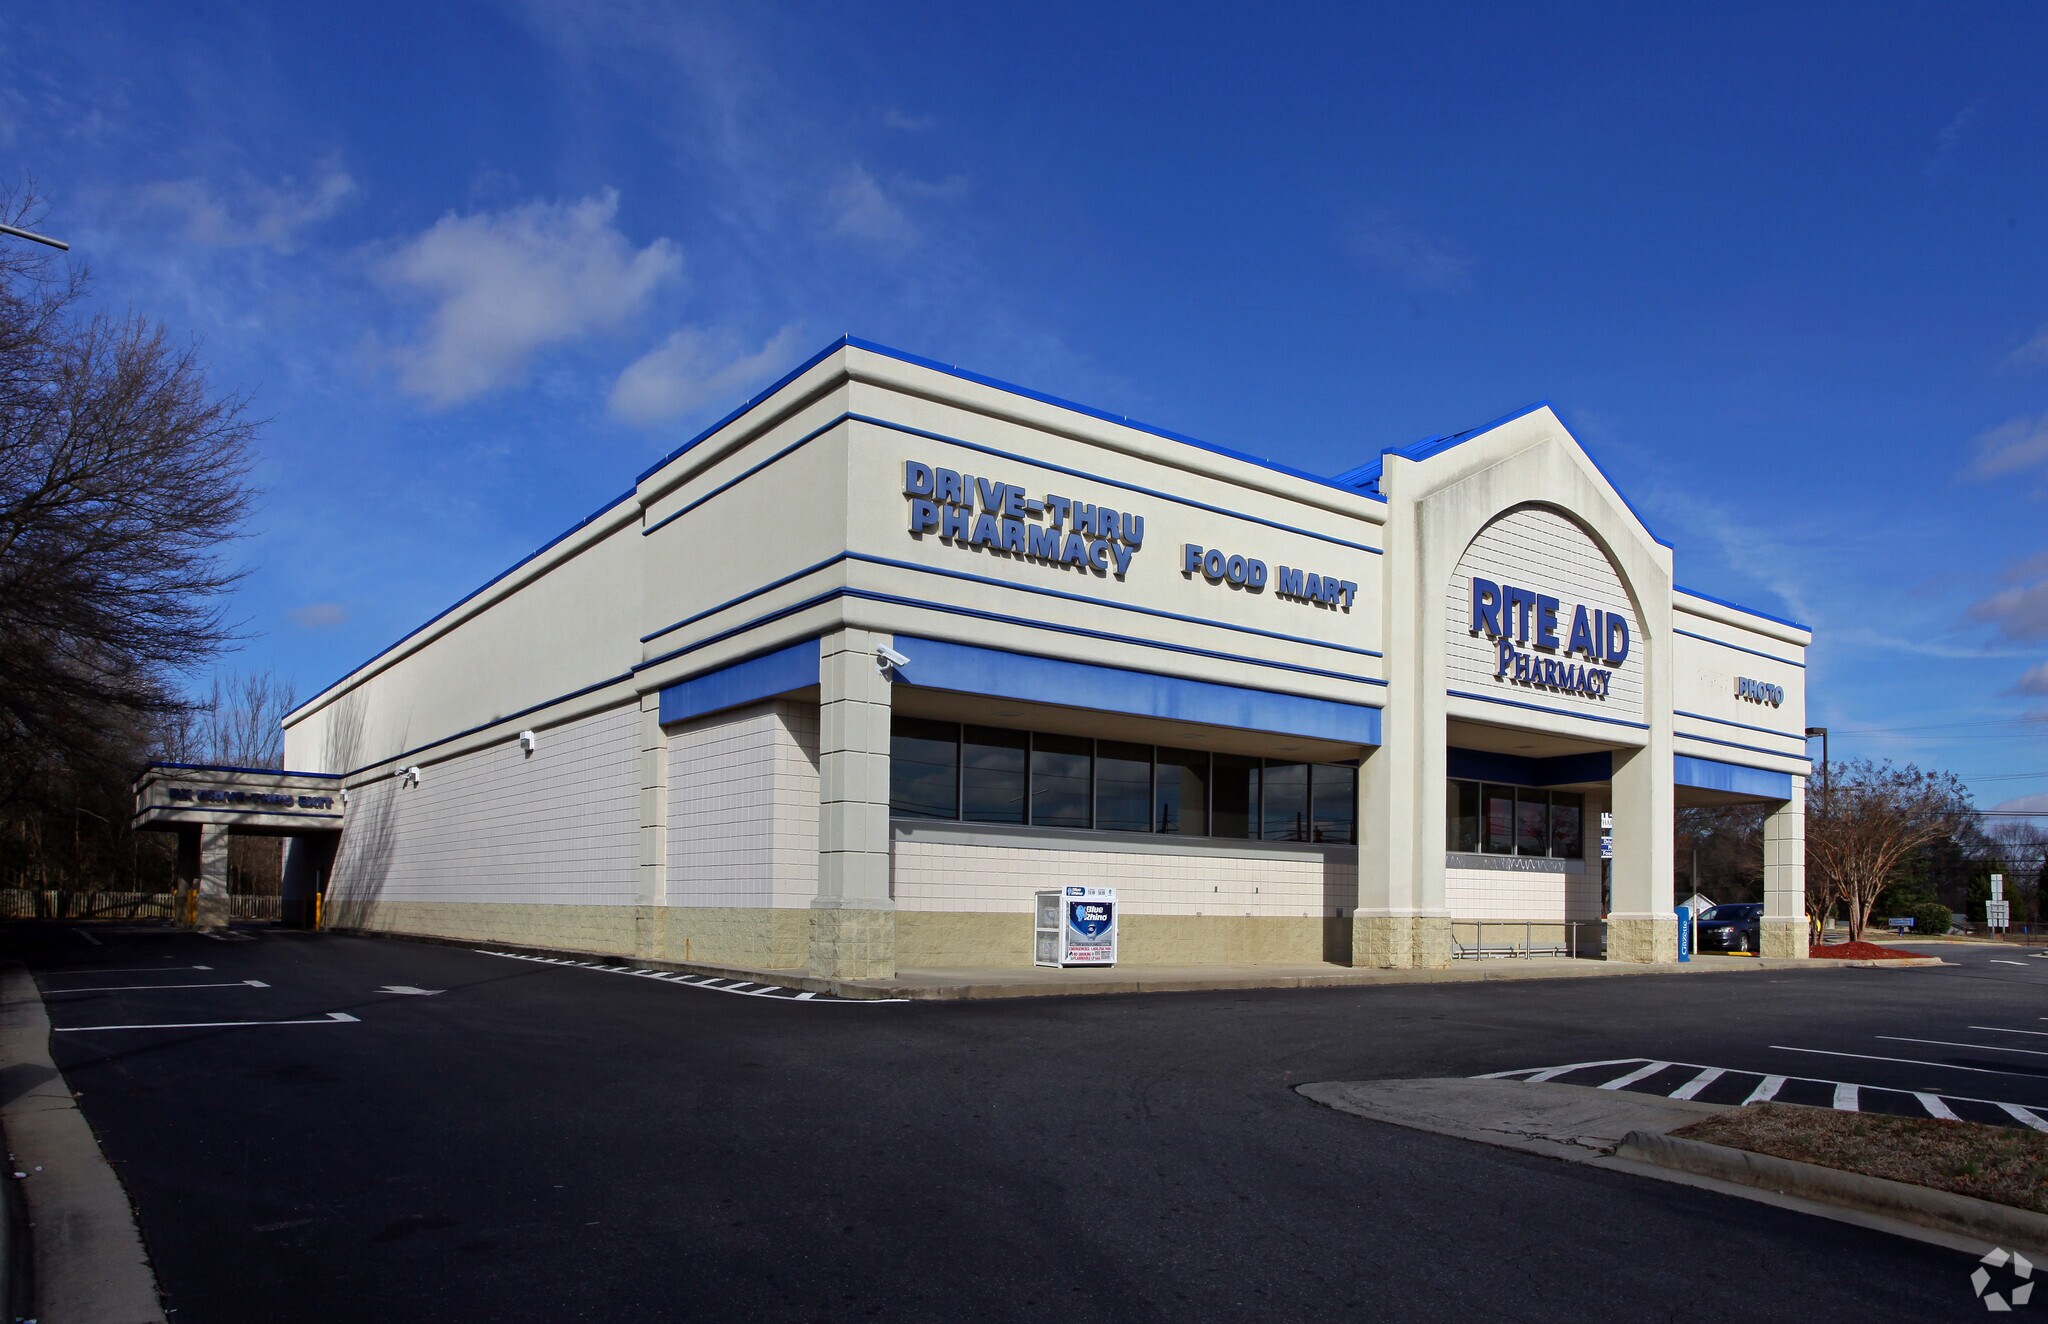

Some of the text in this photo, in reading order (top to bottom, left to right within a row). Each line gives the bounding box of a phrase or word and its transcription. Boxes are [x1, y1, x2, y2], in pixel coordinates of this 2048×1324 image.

[904, 460, 1144, 545] DRIVE-THRU
[910, 498, 1134, 575] PHARMACY
[1181, 543, 1358, 607] FOOD MART
[1469, 576, 1630, 664] RITE AID
[1495, 640, 1612, 696] PHARMACY
[1735, 676, 1784, 704] PHOTO
[298, 796, 334, 809] EXIT
